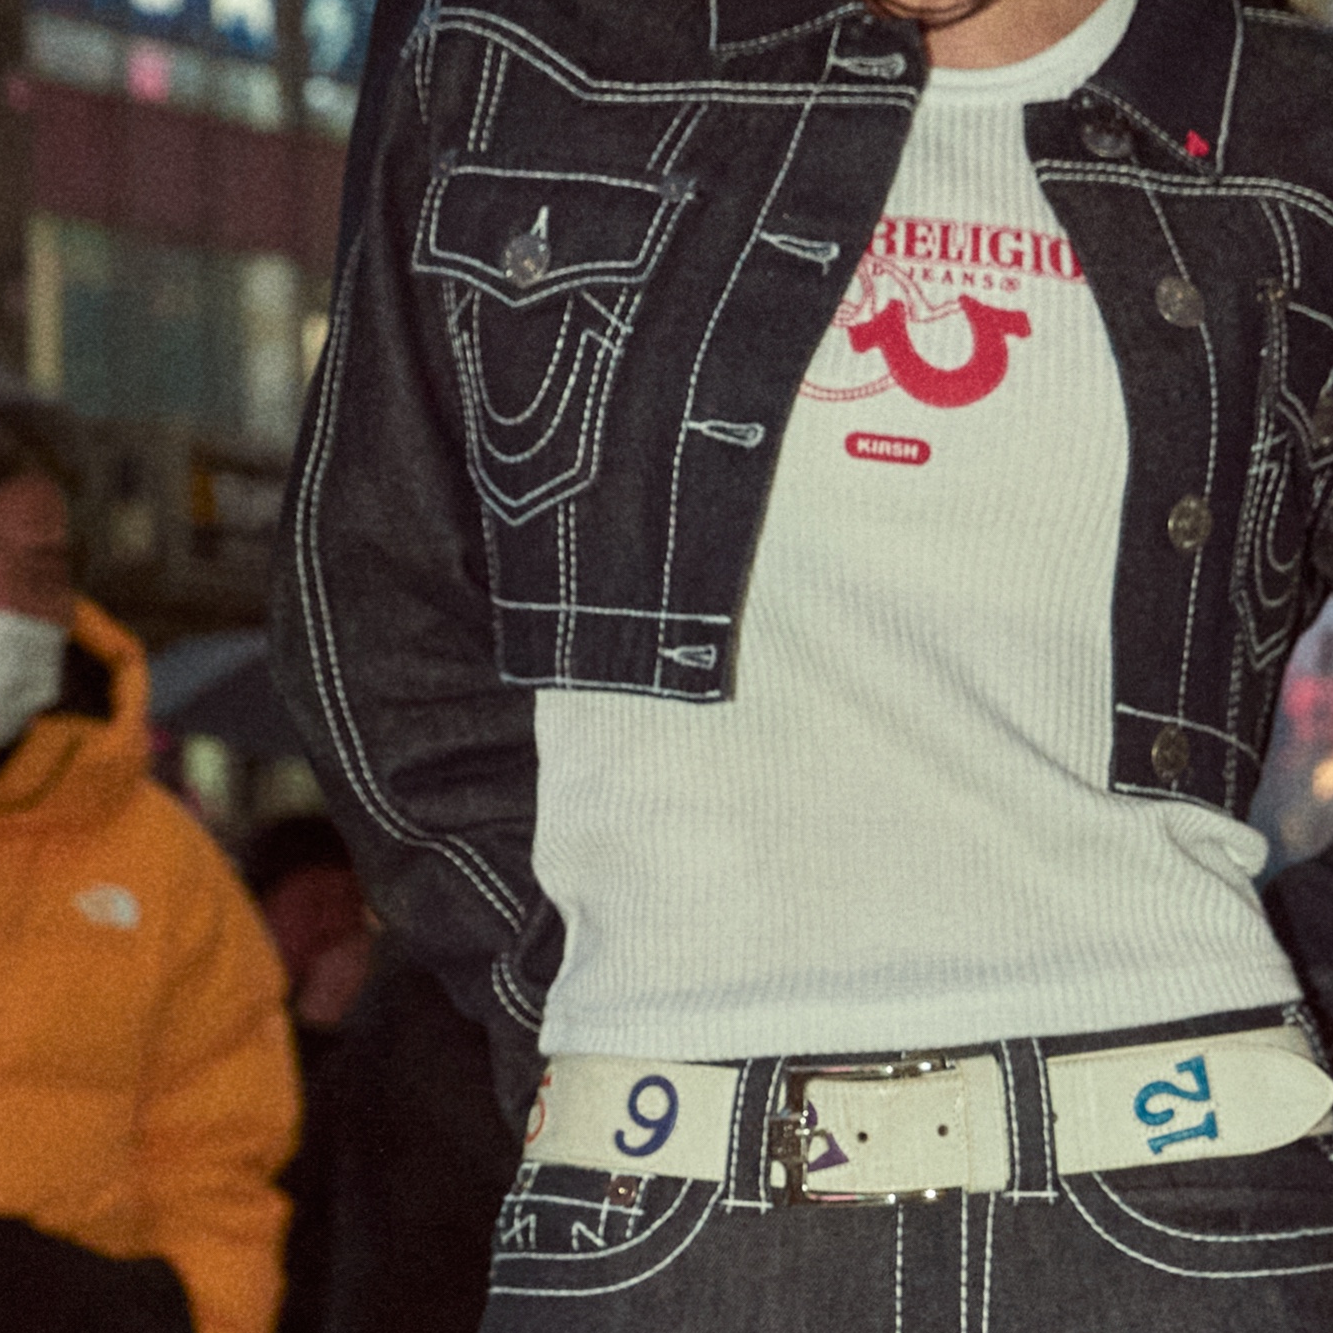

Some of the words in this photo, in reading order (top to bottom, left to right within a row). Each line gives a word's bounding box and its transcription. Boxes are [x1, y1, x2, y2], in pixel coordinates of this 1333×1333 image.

[857, 438, 919, 460] KIRSH
[614, 1074, 679, 1157] 9
[1133, 1055, 1218, 1155] 12
